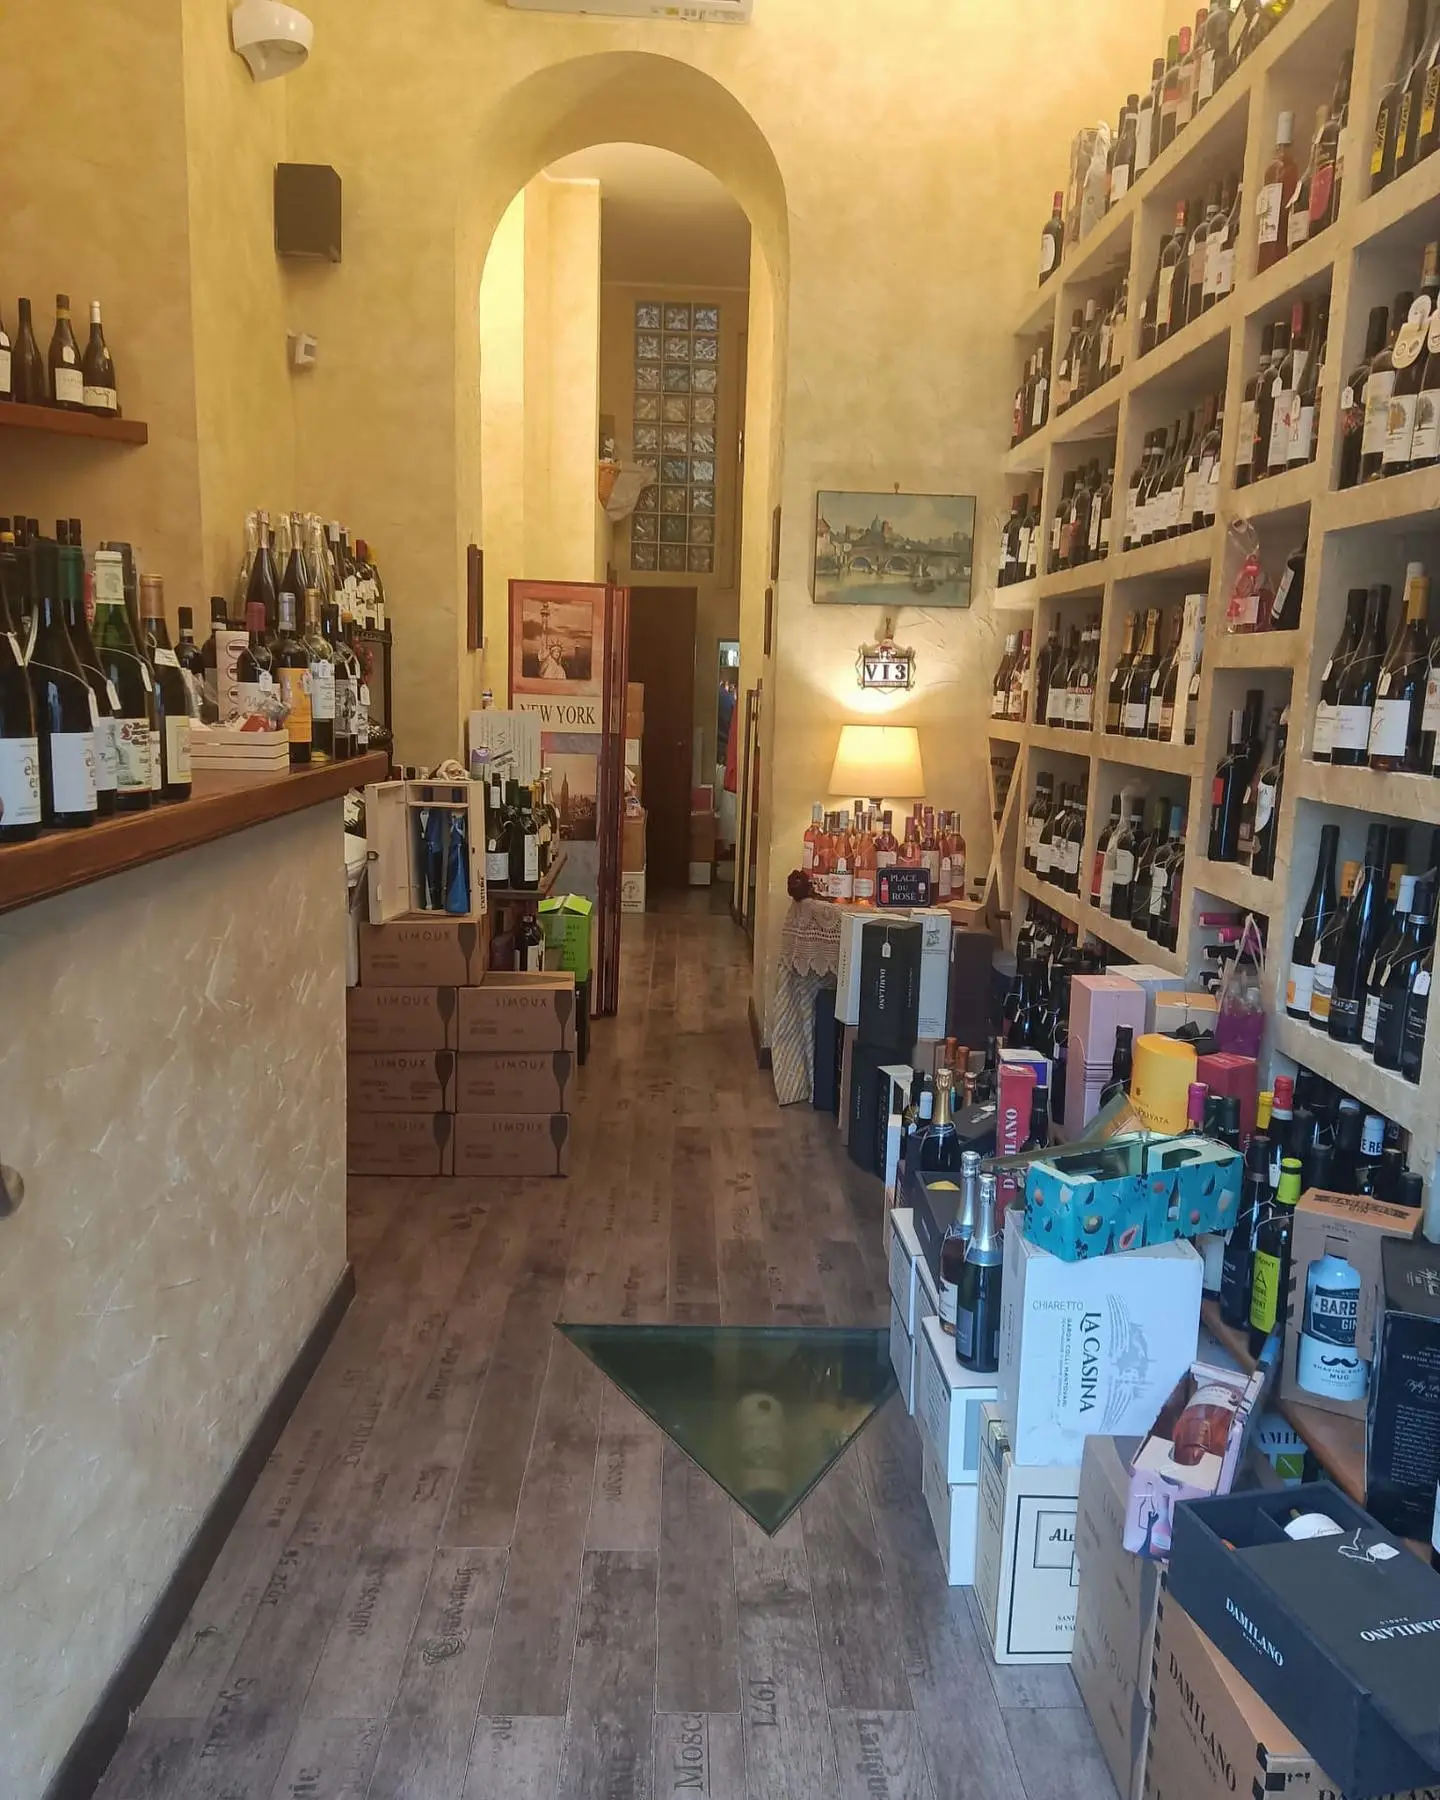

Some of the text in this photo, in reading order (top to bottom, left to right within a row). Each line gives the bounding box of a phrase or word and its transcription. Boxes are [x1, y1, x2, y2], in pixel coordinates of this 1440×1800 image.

[557, 706, 595, 725] YORK
[890, 874, 917, 883] PLACE
[398, 930, 451, 942] LIMOUX
[878, 968, 887, 1010] DAMILANO
[376, 995, 431, 1007] LIMOUX
[495, 996, 547, 1008] LIMOUX
[374, 1059, 427, 1069] LIMOUX
[495, 1060, 545, 1071] LIMOUX
[492, 1122, 543, 1133] LIMOUX
[1003, 1107, 1017, 1190] DILANO
[1032, 1300, 1084, 1311] CHIARETTO
[1079, 1311, 1102, 1414] LA CASINA
[1329, 1373, 1350, 1381] MUG
[1225, 1596, 1284, 1667] DAMILANO
[748, 1676, 780, 1729] 1971
[1169, 1652, 1237, 1792] DAMILANO
